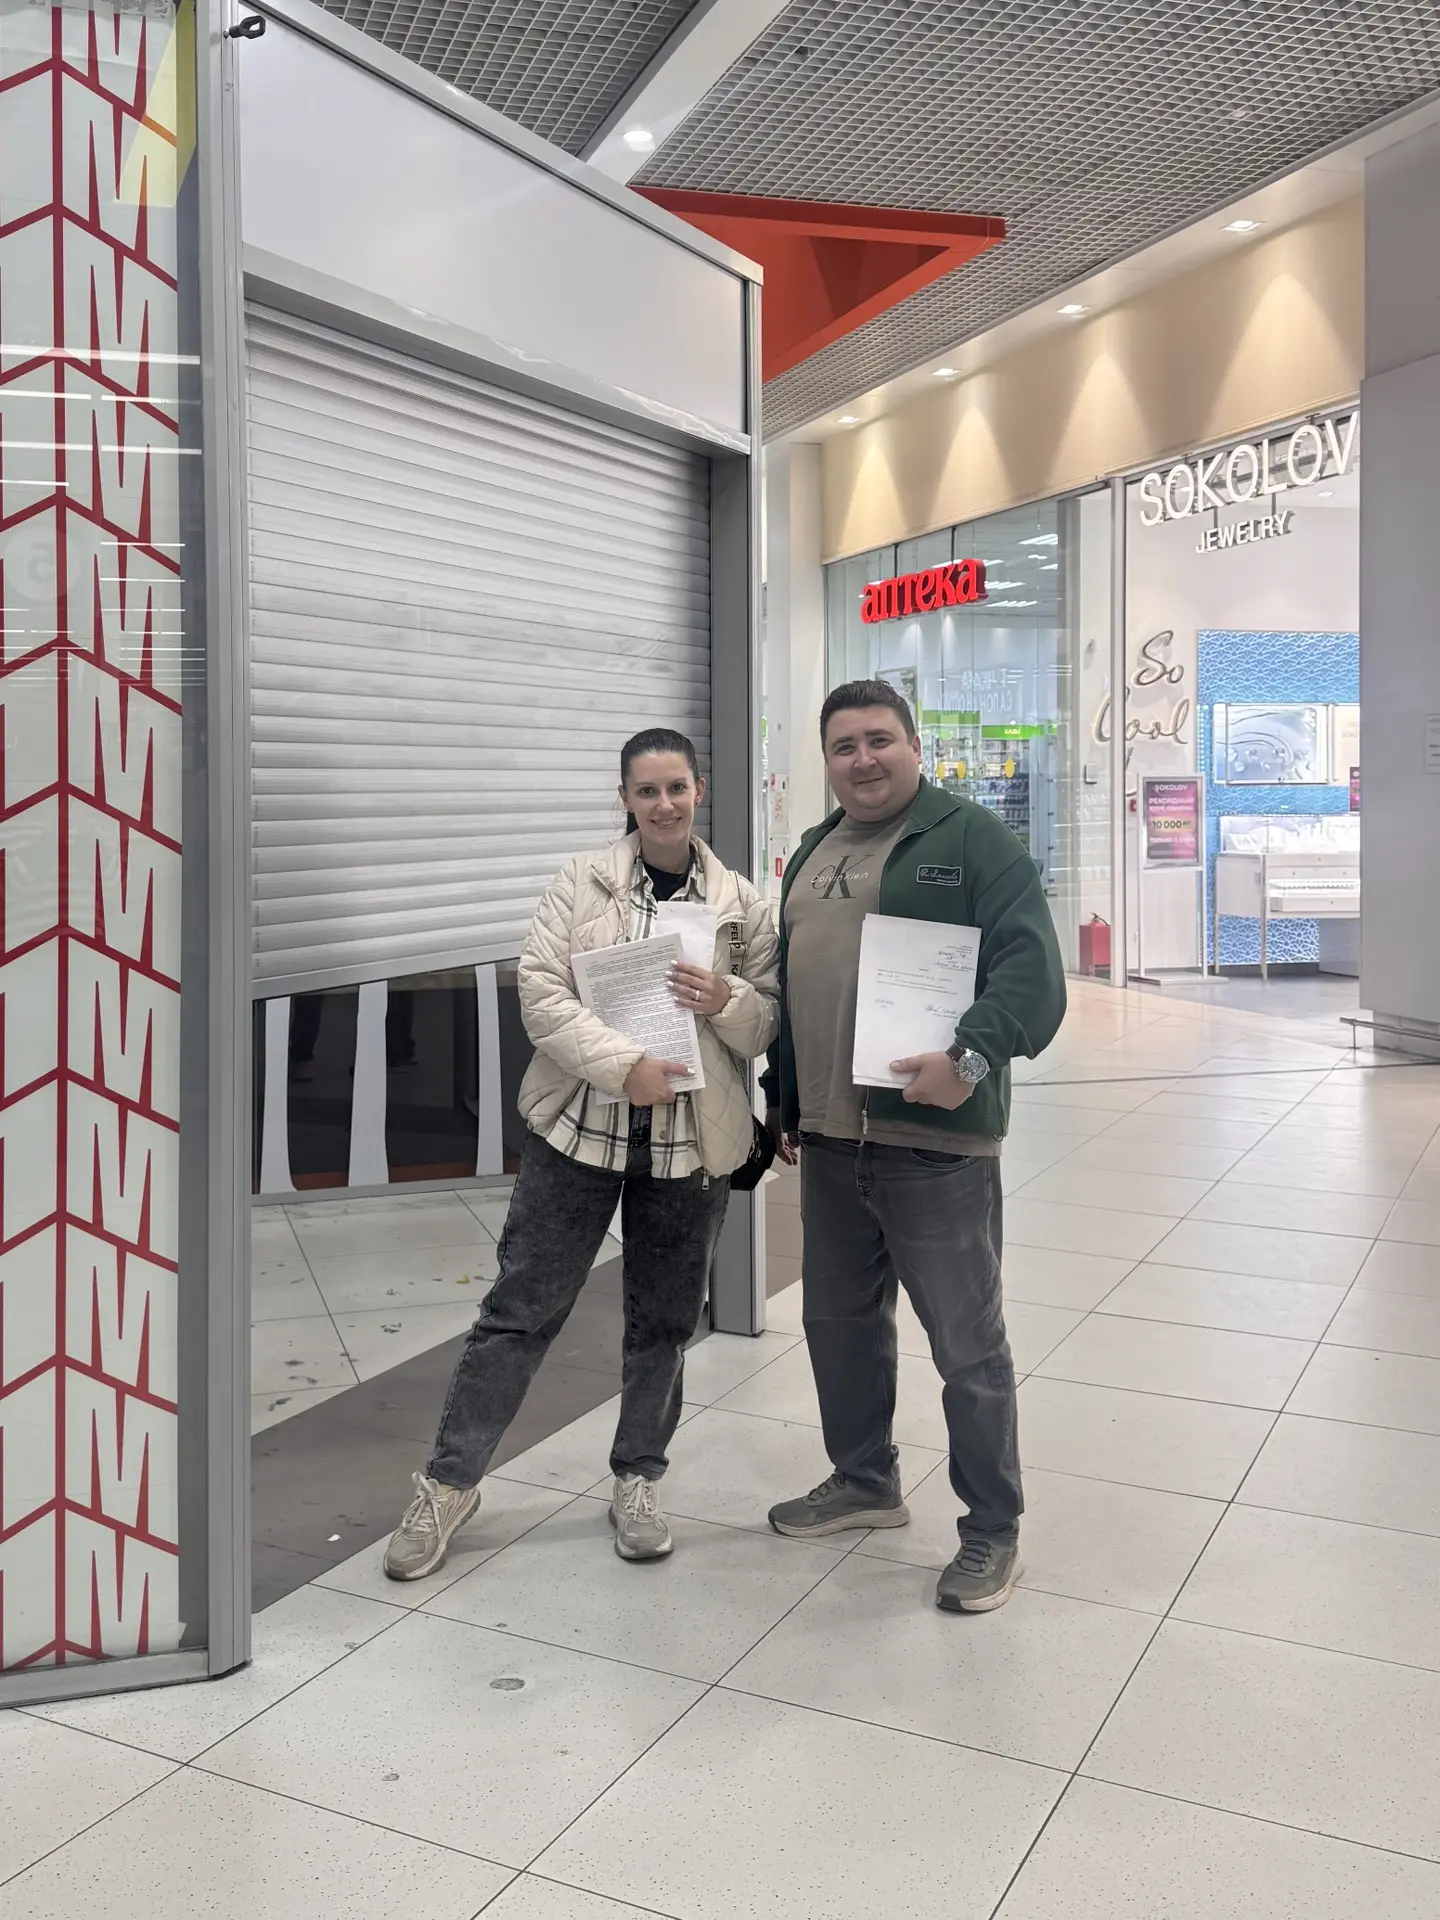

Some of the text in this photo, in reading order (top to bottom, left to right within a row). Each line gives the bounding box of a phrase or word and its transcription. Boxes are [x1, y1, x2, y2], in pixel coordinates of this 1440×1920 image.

[1140, 411, 1359, 526] SOKOLOV
[1196, 510, 1291, 553] JEWELRY
[861, 557, 983, 624] аптека
[1135, 630, 1185, 686] So
[1154, 784, 1188, 792] SOKOLOV
[1152, 820, 1162, 829] 10
[1163, 820, 1182, 829] 000
[844, 872, 869, 880] Klein
